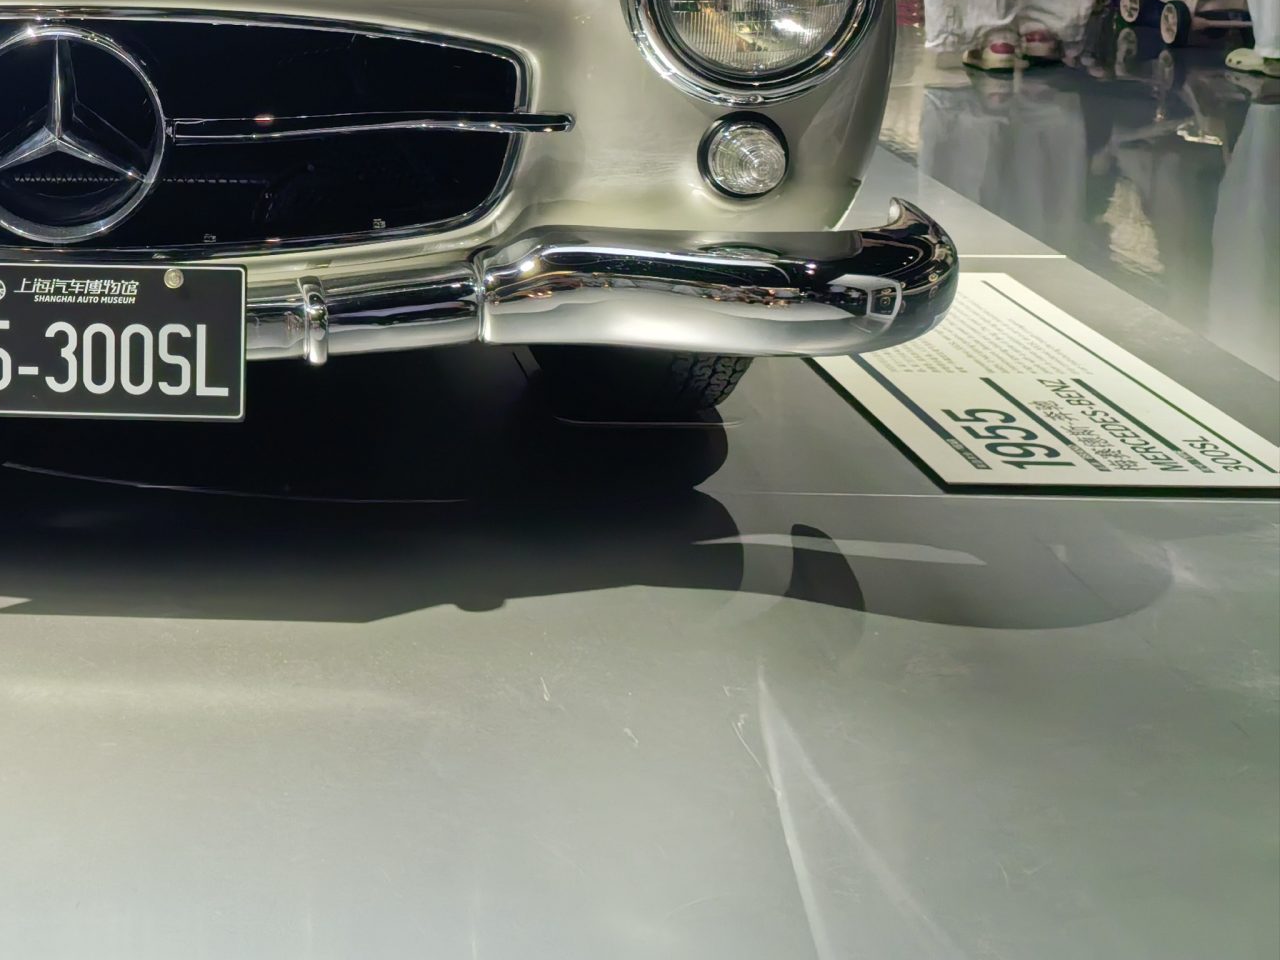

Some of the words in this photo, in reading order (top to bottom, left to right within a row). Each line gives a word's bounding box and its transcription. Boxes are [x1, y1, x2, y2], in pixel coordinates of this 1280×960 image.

[14, 277, 140, 296] 上海汽车博物馆
[33, 294, 76, 303] SHANGHAI
[77, 295, 99, 304] AUTO
[100, 296, 136, 304] MUSEUM
[940, 408, 1076, 470] 1955
[1036, 378, 1190, 472] MERCEDES-BENZ
[1181, 435, 1255, 473] 300SL
